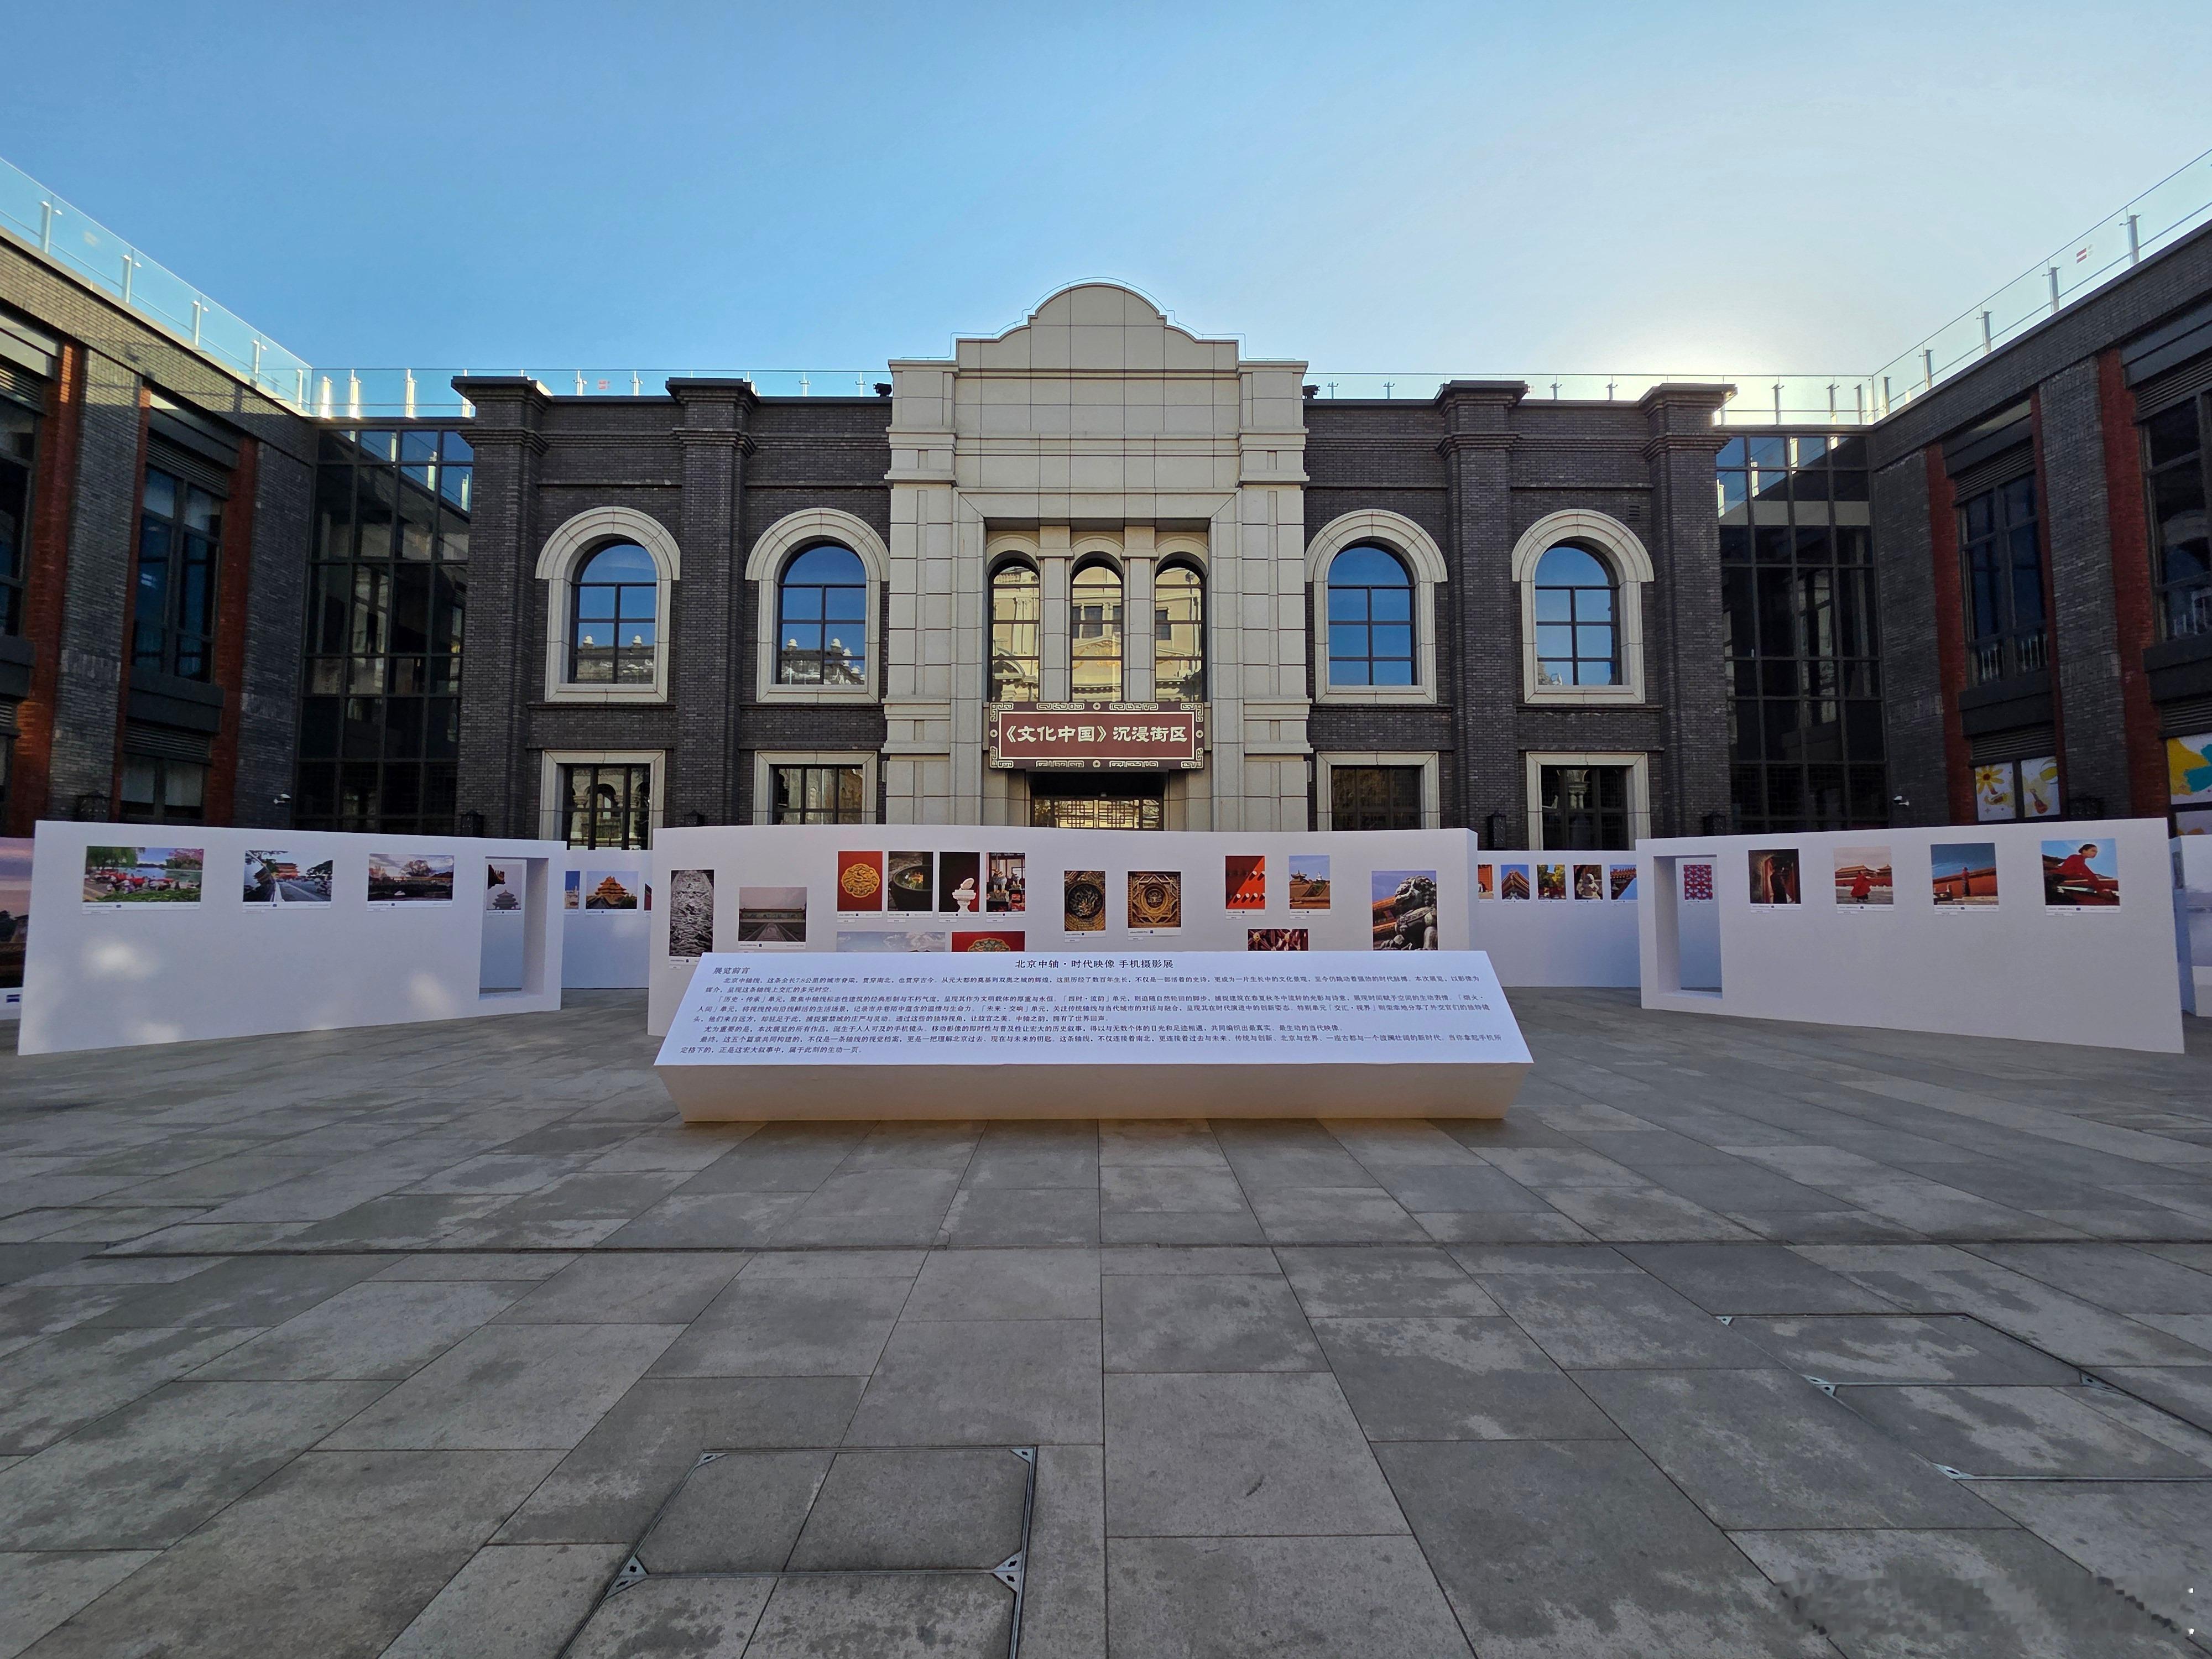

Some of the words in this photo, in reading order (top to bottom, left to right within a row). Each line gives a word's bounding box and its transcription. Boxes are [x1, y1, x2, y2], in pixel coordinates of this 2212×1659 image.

[1006, 725, 1188, 743] 《文化中国》沉浸街区
[1118, 959, 1173, 968] 手机摄影展
